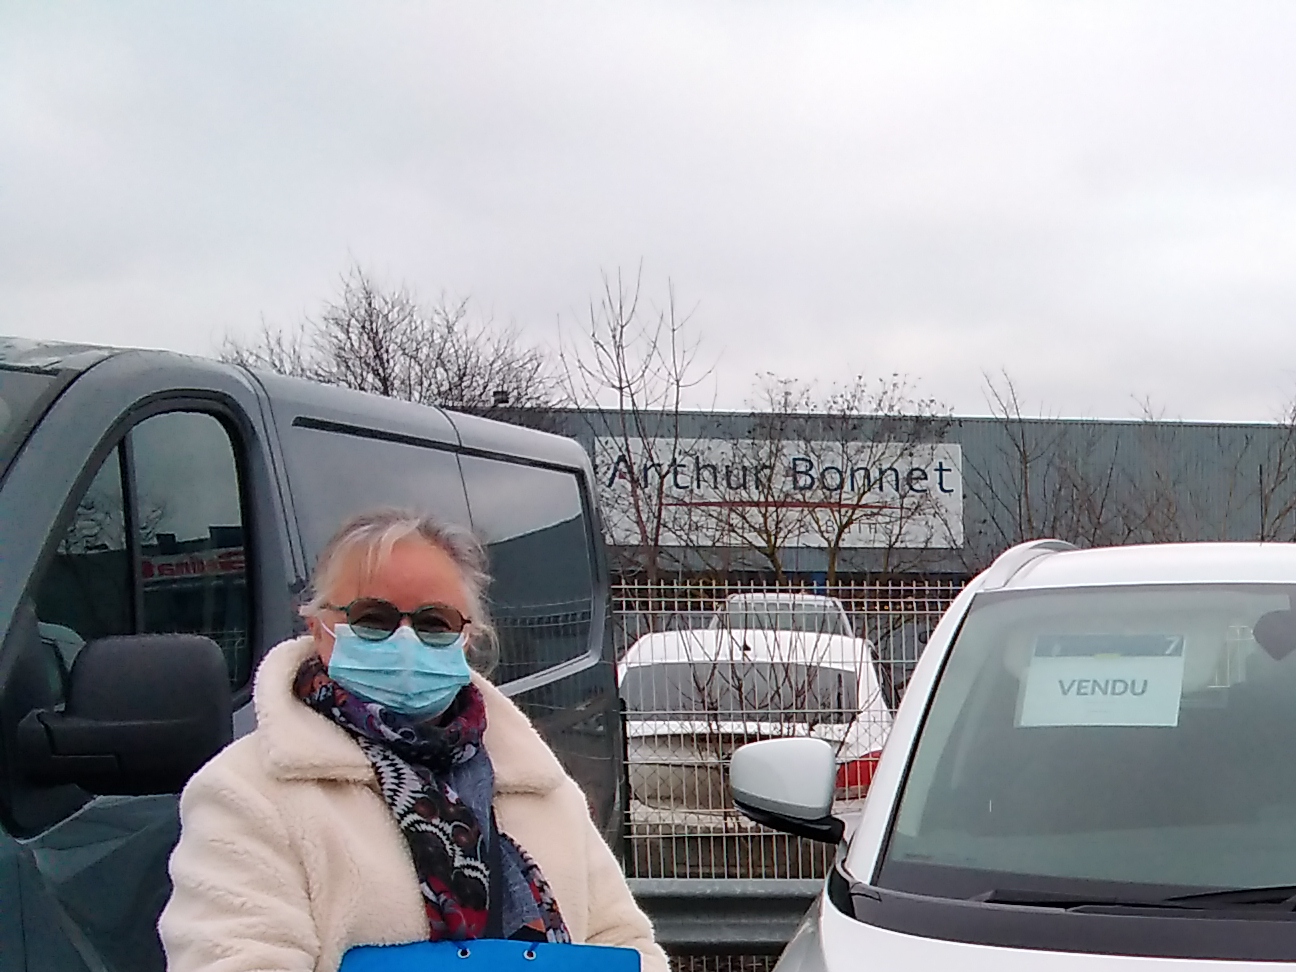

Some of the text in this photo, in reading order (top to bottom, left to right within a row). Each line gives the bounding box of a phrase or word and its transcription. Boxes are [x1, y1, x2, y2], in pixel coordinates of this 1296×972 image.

[606, 453, 955, 495] Arthur Bonnet
[1057, 678, 1149, 697] VENDU
